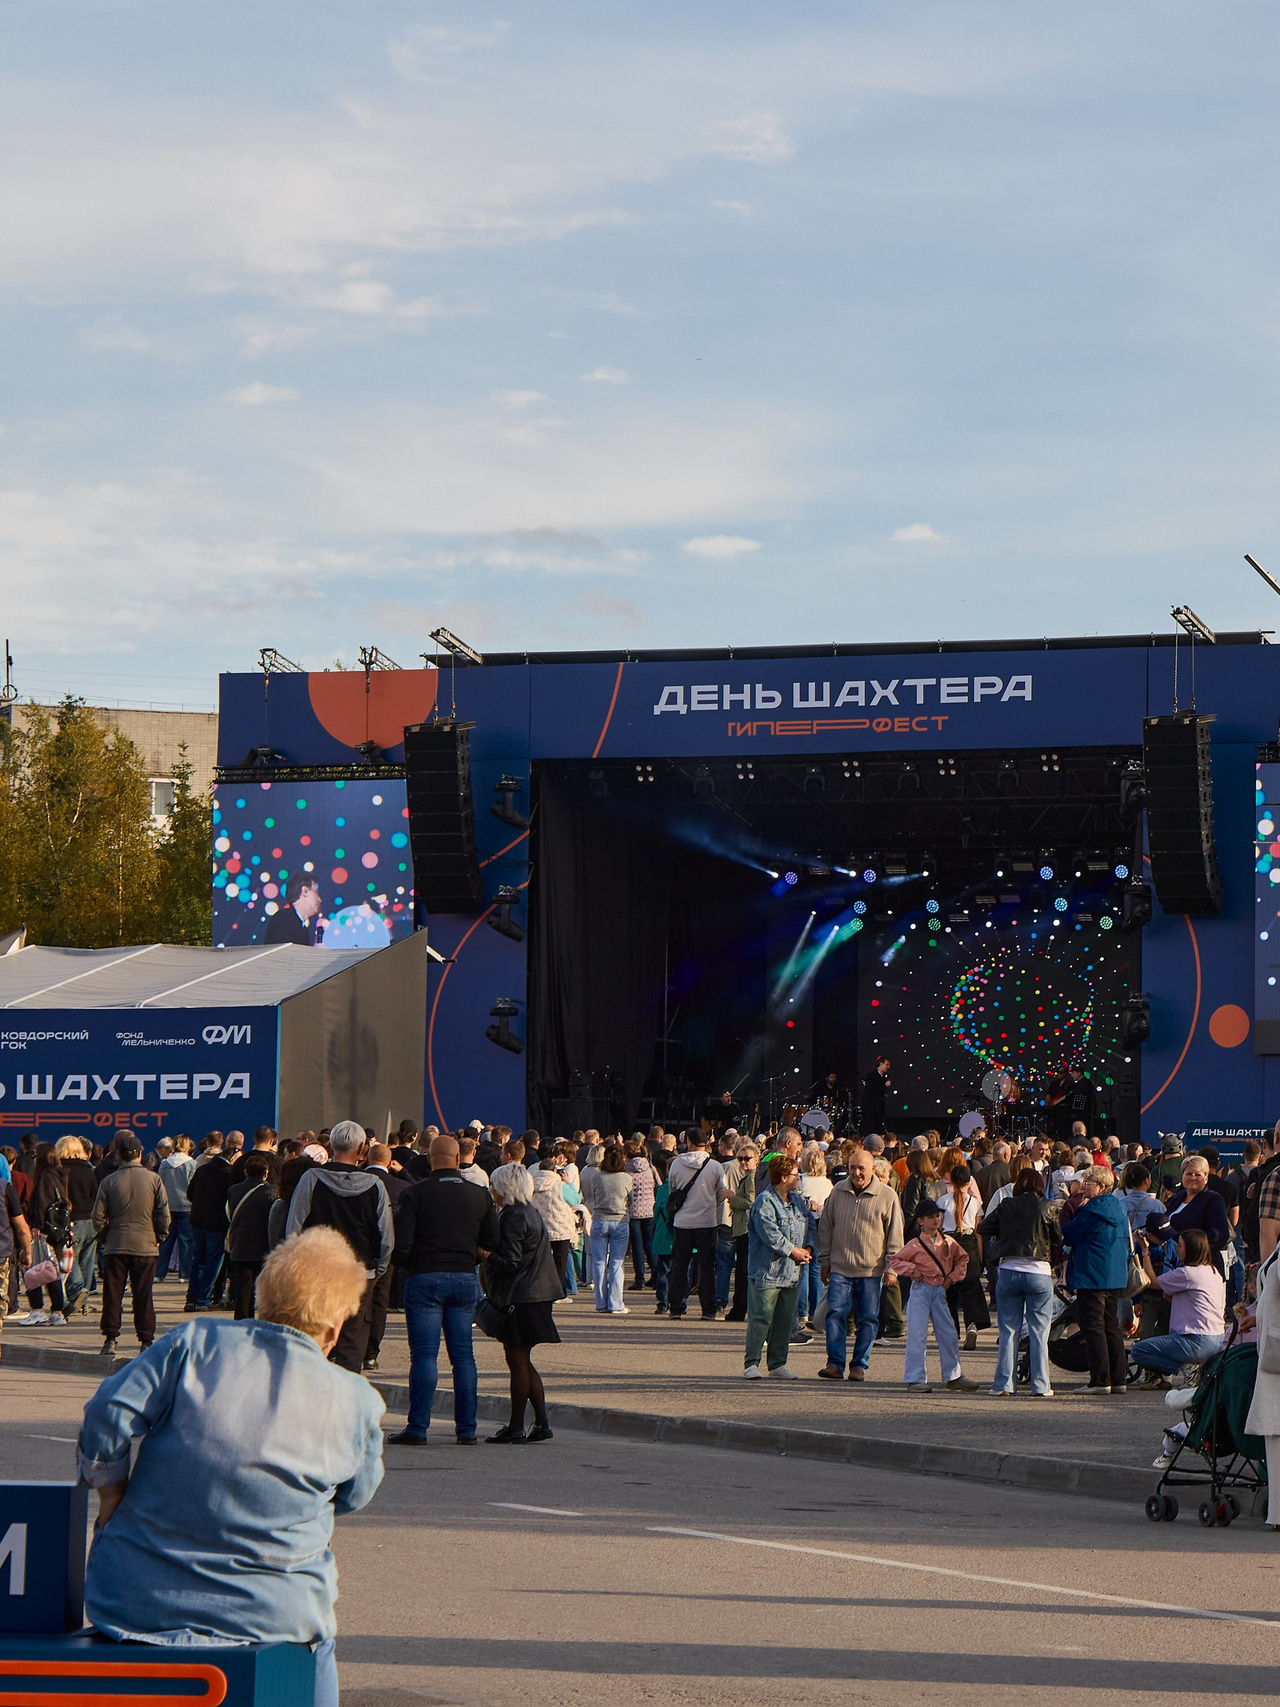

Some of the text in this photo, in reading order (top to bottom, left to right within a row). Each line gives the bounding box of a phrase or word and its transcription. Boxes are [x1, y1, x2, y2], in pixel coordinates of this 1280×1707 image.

[653, 674, 1033, 716] ДЕНЬ ШАХТЕРА
[727, 715, 949, 737] ГИПЕРФЕСТ
[1, 1029, 89, 1041] КОВДОРСКИЙ
[115, 1032, 144, 1040] ФОНД
[1, 1041, 27, 1050] ГОК
[121, 1038, 196, 1047] МЕЛЬНИЧЕНКО
[16, 1072, 251, 1101] ШАХТЕРА
[1192, 1128, 1224, 1137] ДЕНЬ
